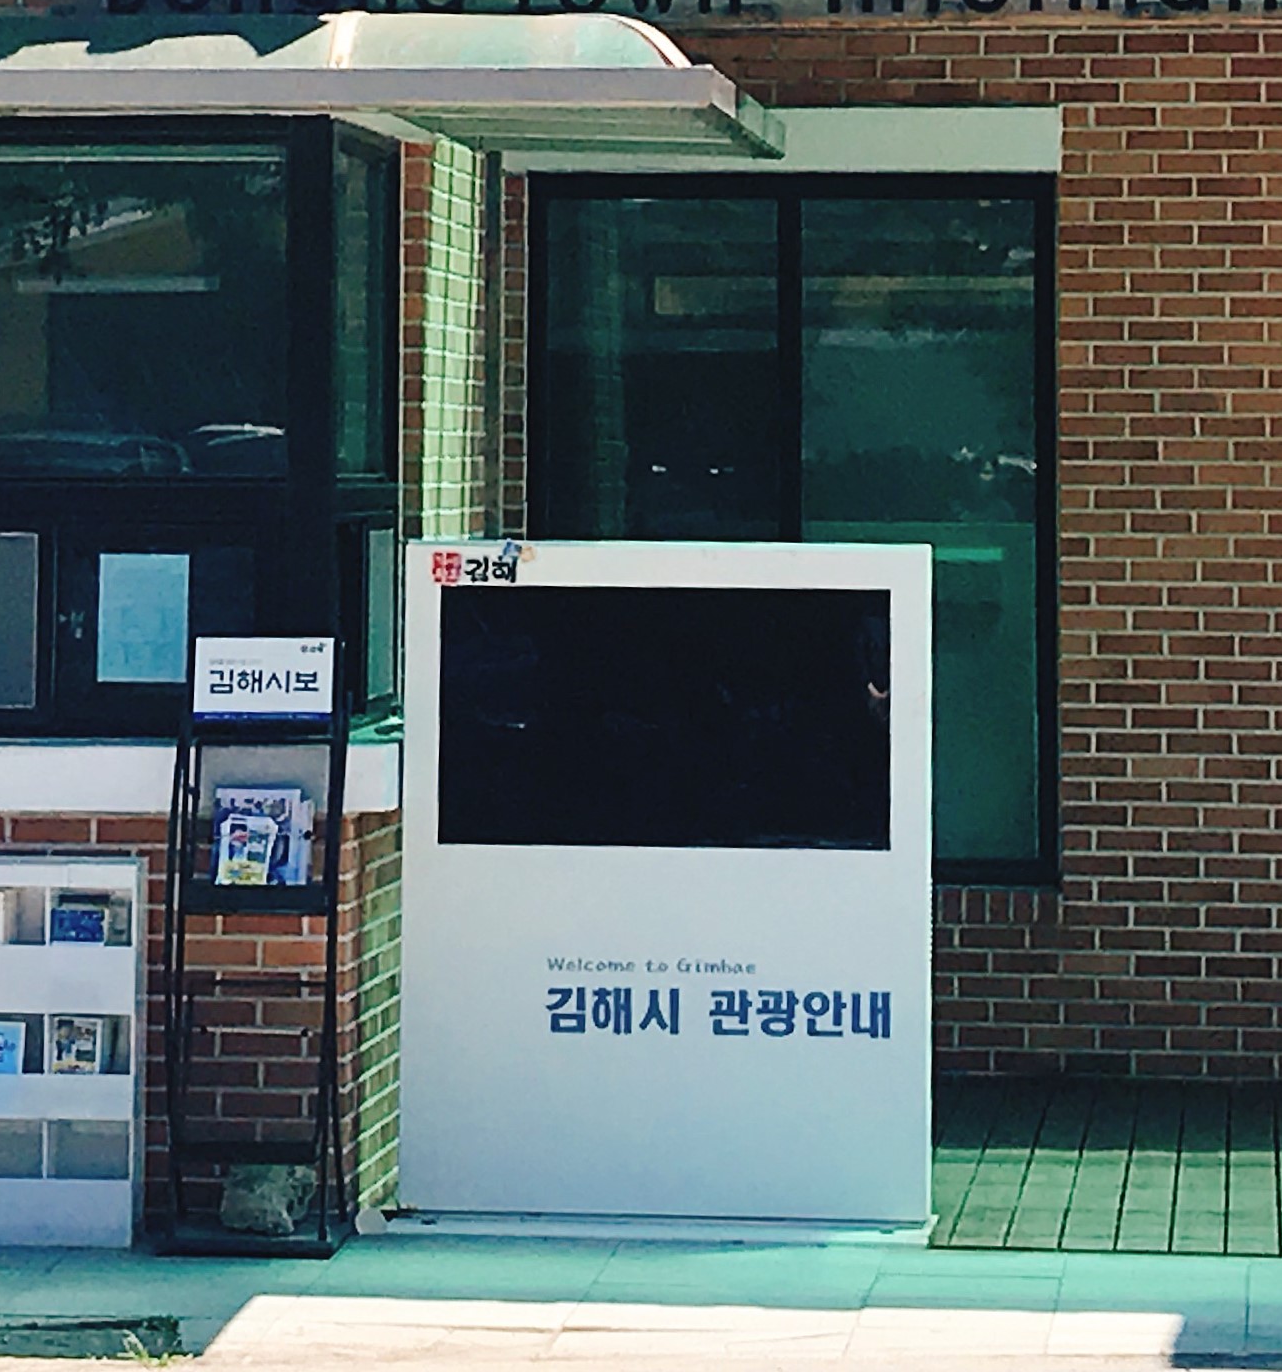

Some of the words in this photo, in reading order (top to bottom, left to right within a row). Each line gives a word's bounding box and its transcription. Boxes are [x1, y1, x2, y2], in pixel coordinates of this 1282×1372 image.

[464, 555, 518, 584] 김해
[209, 668, 320, 695] 김해시보
[547, 957, 635, 972] Welcome
[645, 959, 668, 973] to
[676, 958, 757, 975] Gimhae
[545, 986, 681, 1036] 김해시
[709, 989, 893, 1039] 관광안내
